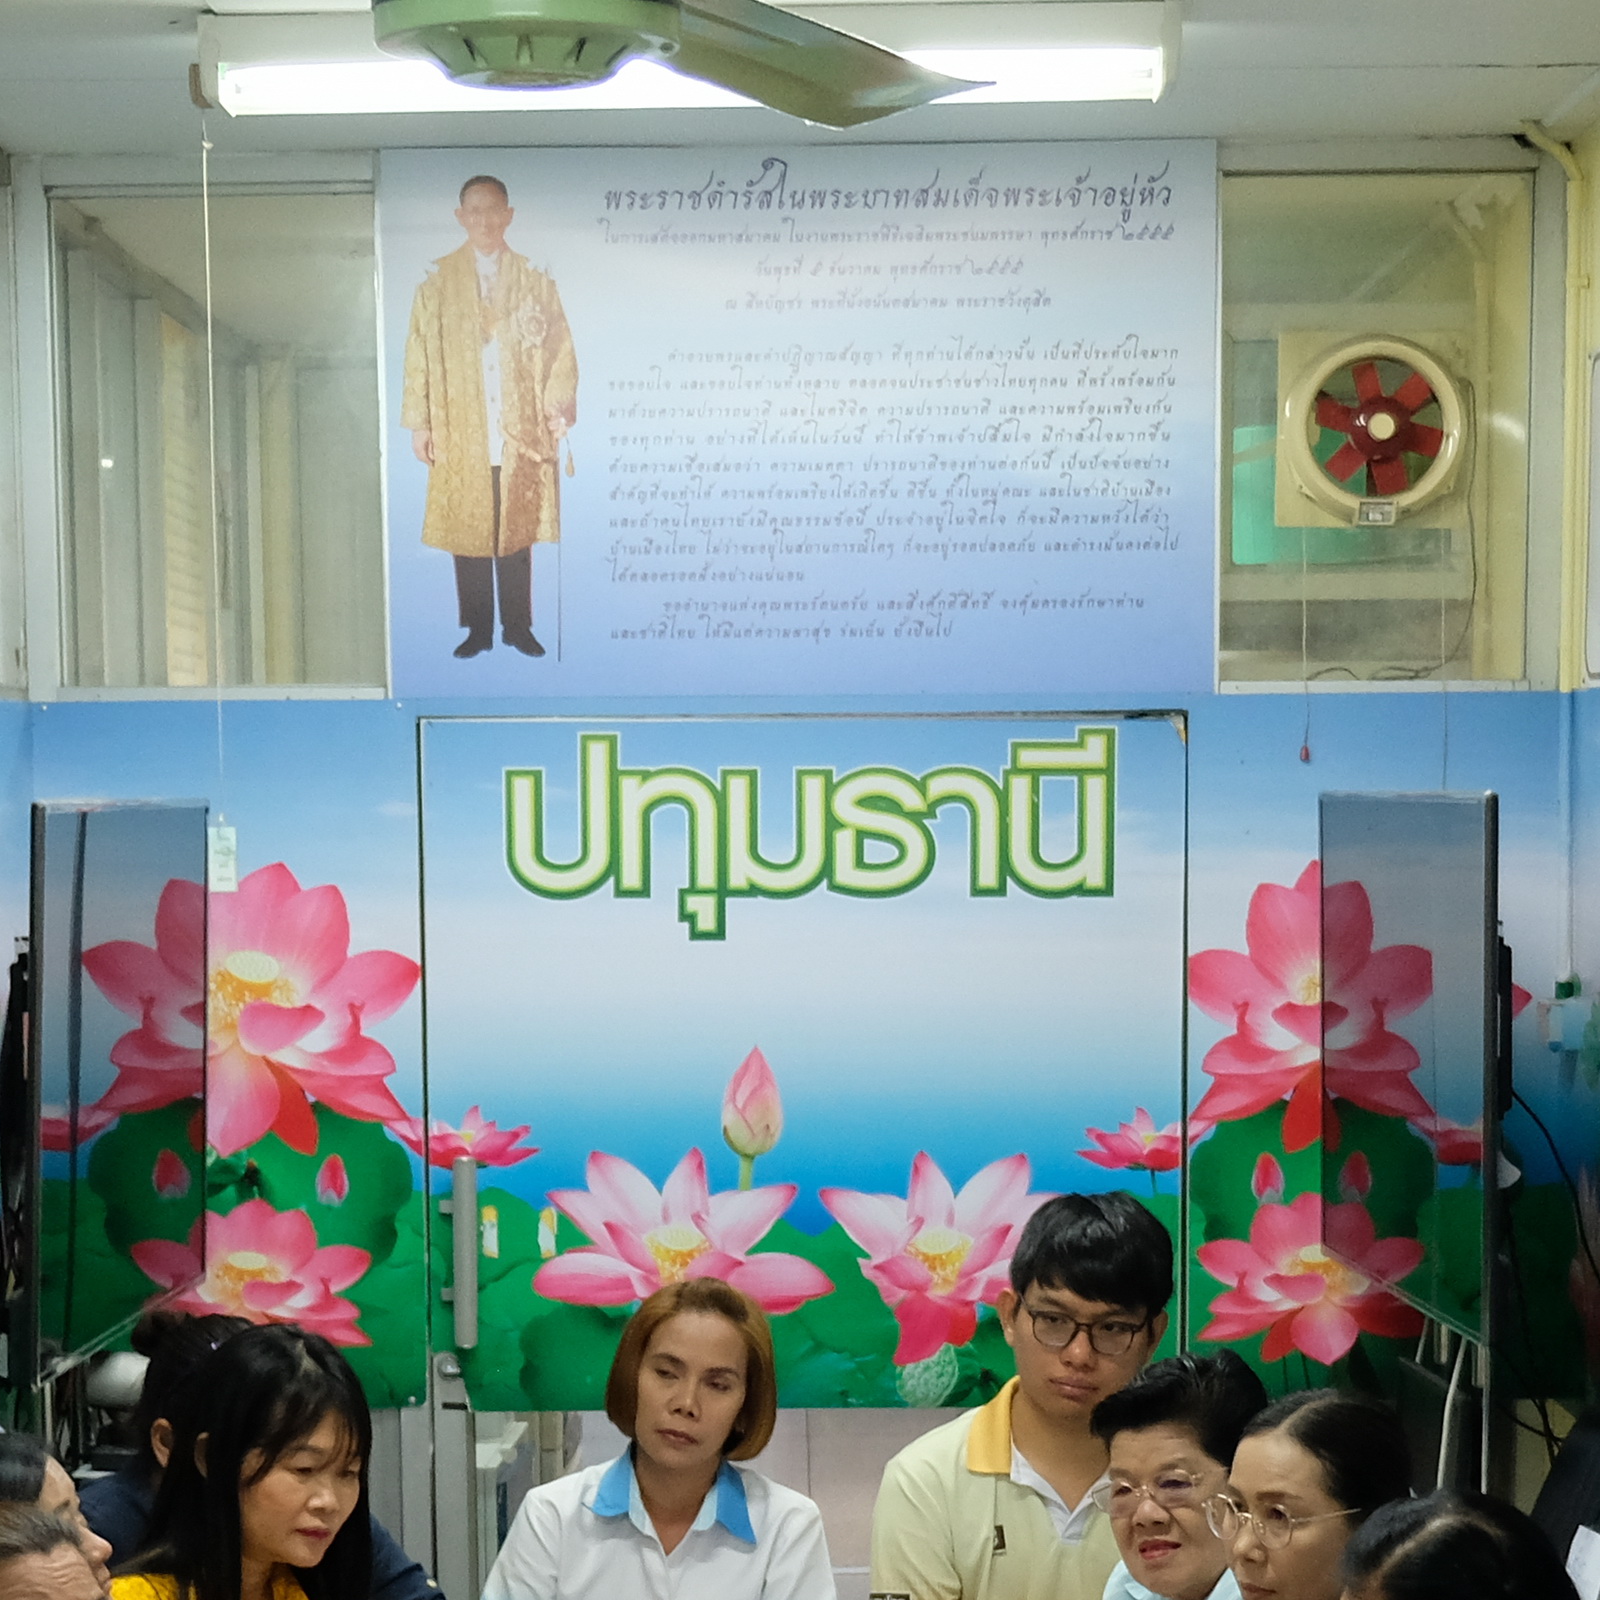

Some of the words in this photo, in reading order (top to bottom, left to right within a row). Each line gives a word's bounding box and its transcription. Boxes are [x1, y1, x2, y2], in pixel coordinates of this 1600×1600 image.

[604, 157, 1172, 223] พระราชดำรัสในพระบาทสมเด็จพระเจ้าอยู่หัว
[503, 727, 1117, 942] ปทุมธานี
